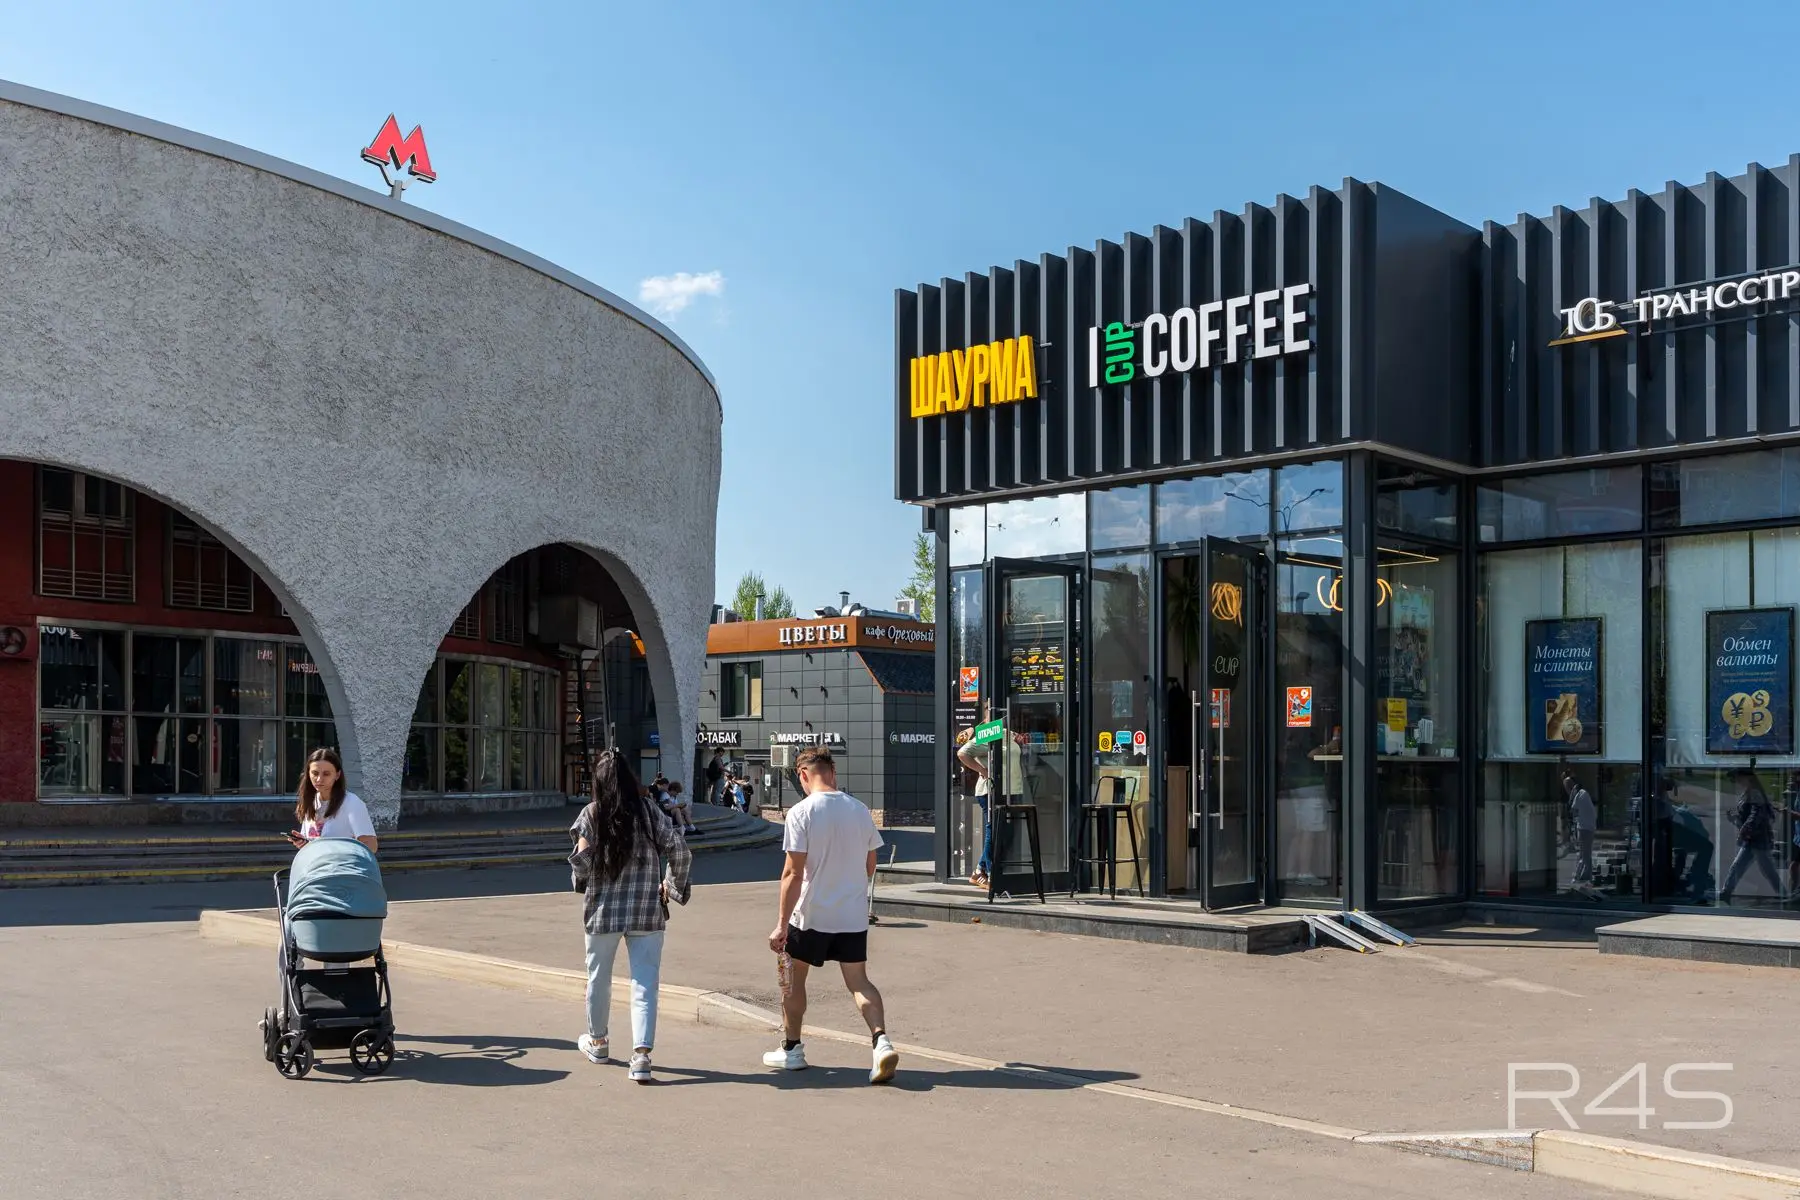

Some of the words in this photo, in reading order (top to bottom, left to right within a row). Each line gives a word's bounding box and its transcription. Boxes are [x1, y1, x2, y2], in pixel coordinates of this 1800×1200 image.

[361, 112, 436, 182] М
[1105, 321, 1135, 385] CUP
[1143, 283, 1310, 377] COFFEE
[911, 335, 1037, 418] ШАУРМА
[779, 624, 846, 644] ЦВЕТЫ
[865, 626, 886, 638] кафе
[887, 625, 935, 644] Ореховый
[1723, 636, 1772, 652] Обмен
[1535, 646, 1592, 660] Монеты
[1716, 653, 1779, 667] валюты
[1534, 663, 1542, 673] и
[1543, 661, 1593, 673] слитки
[777, 733, 819, 743] МАРКЕТ
[977, 725, 1001, 740] ОТКРЫТО
